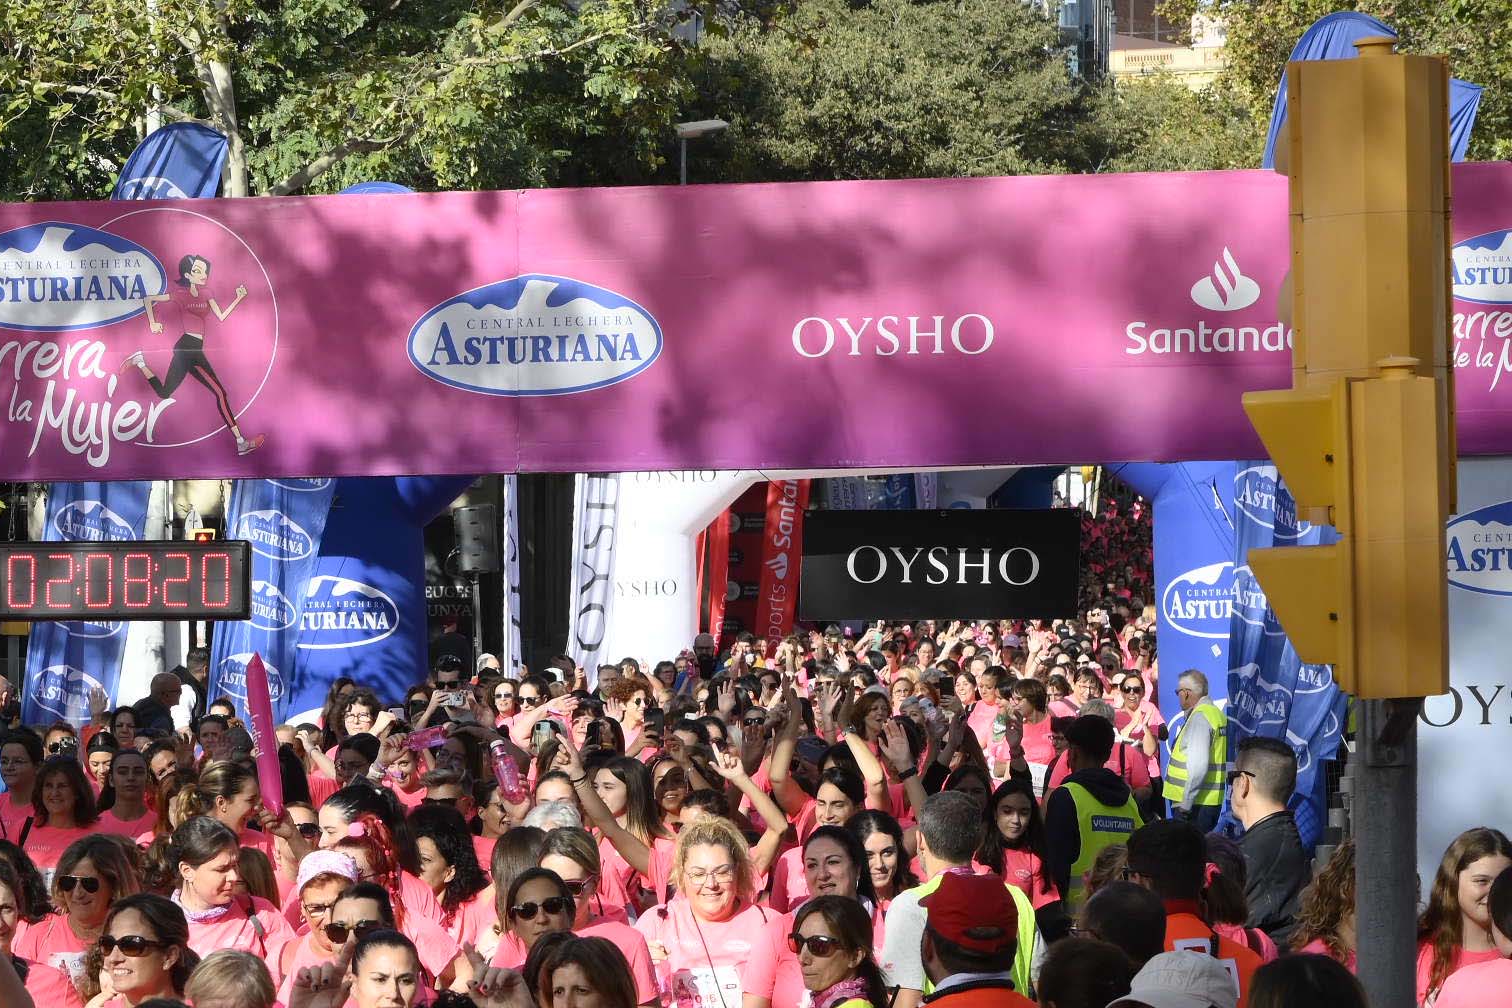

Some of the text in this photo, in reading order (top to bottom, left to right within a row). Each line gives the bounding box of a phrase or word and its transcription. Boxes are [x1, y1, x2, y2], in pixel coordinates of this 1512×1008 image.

[70, 258, 142, 270] LECHERA
[427, 321, 642, 366] ASTURIANA
[467, 315, 634, 329] CENTRAL LECHERA
[792, 313, 994, 358] OYSHO
[8, 382, 32, 422] la
[28, 374, 176, 468] Mujer
[239, 520, 303, 555] ASTURIANA
[8, 553, 229, 608] 02:08:20
[846, 545, 1040, 586] OYSHO
[1418, 684, 1512, 727] OY
